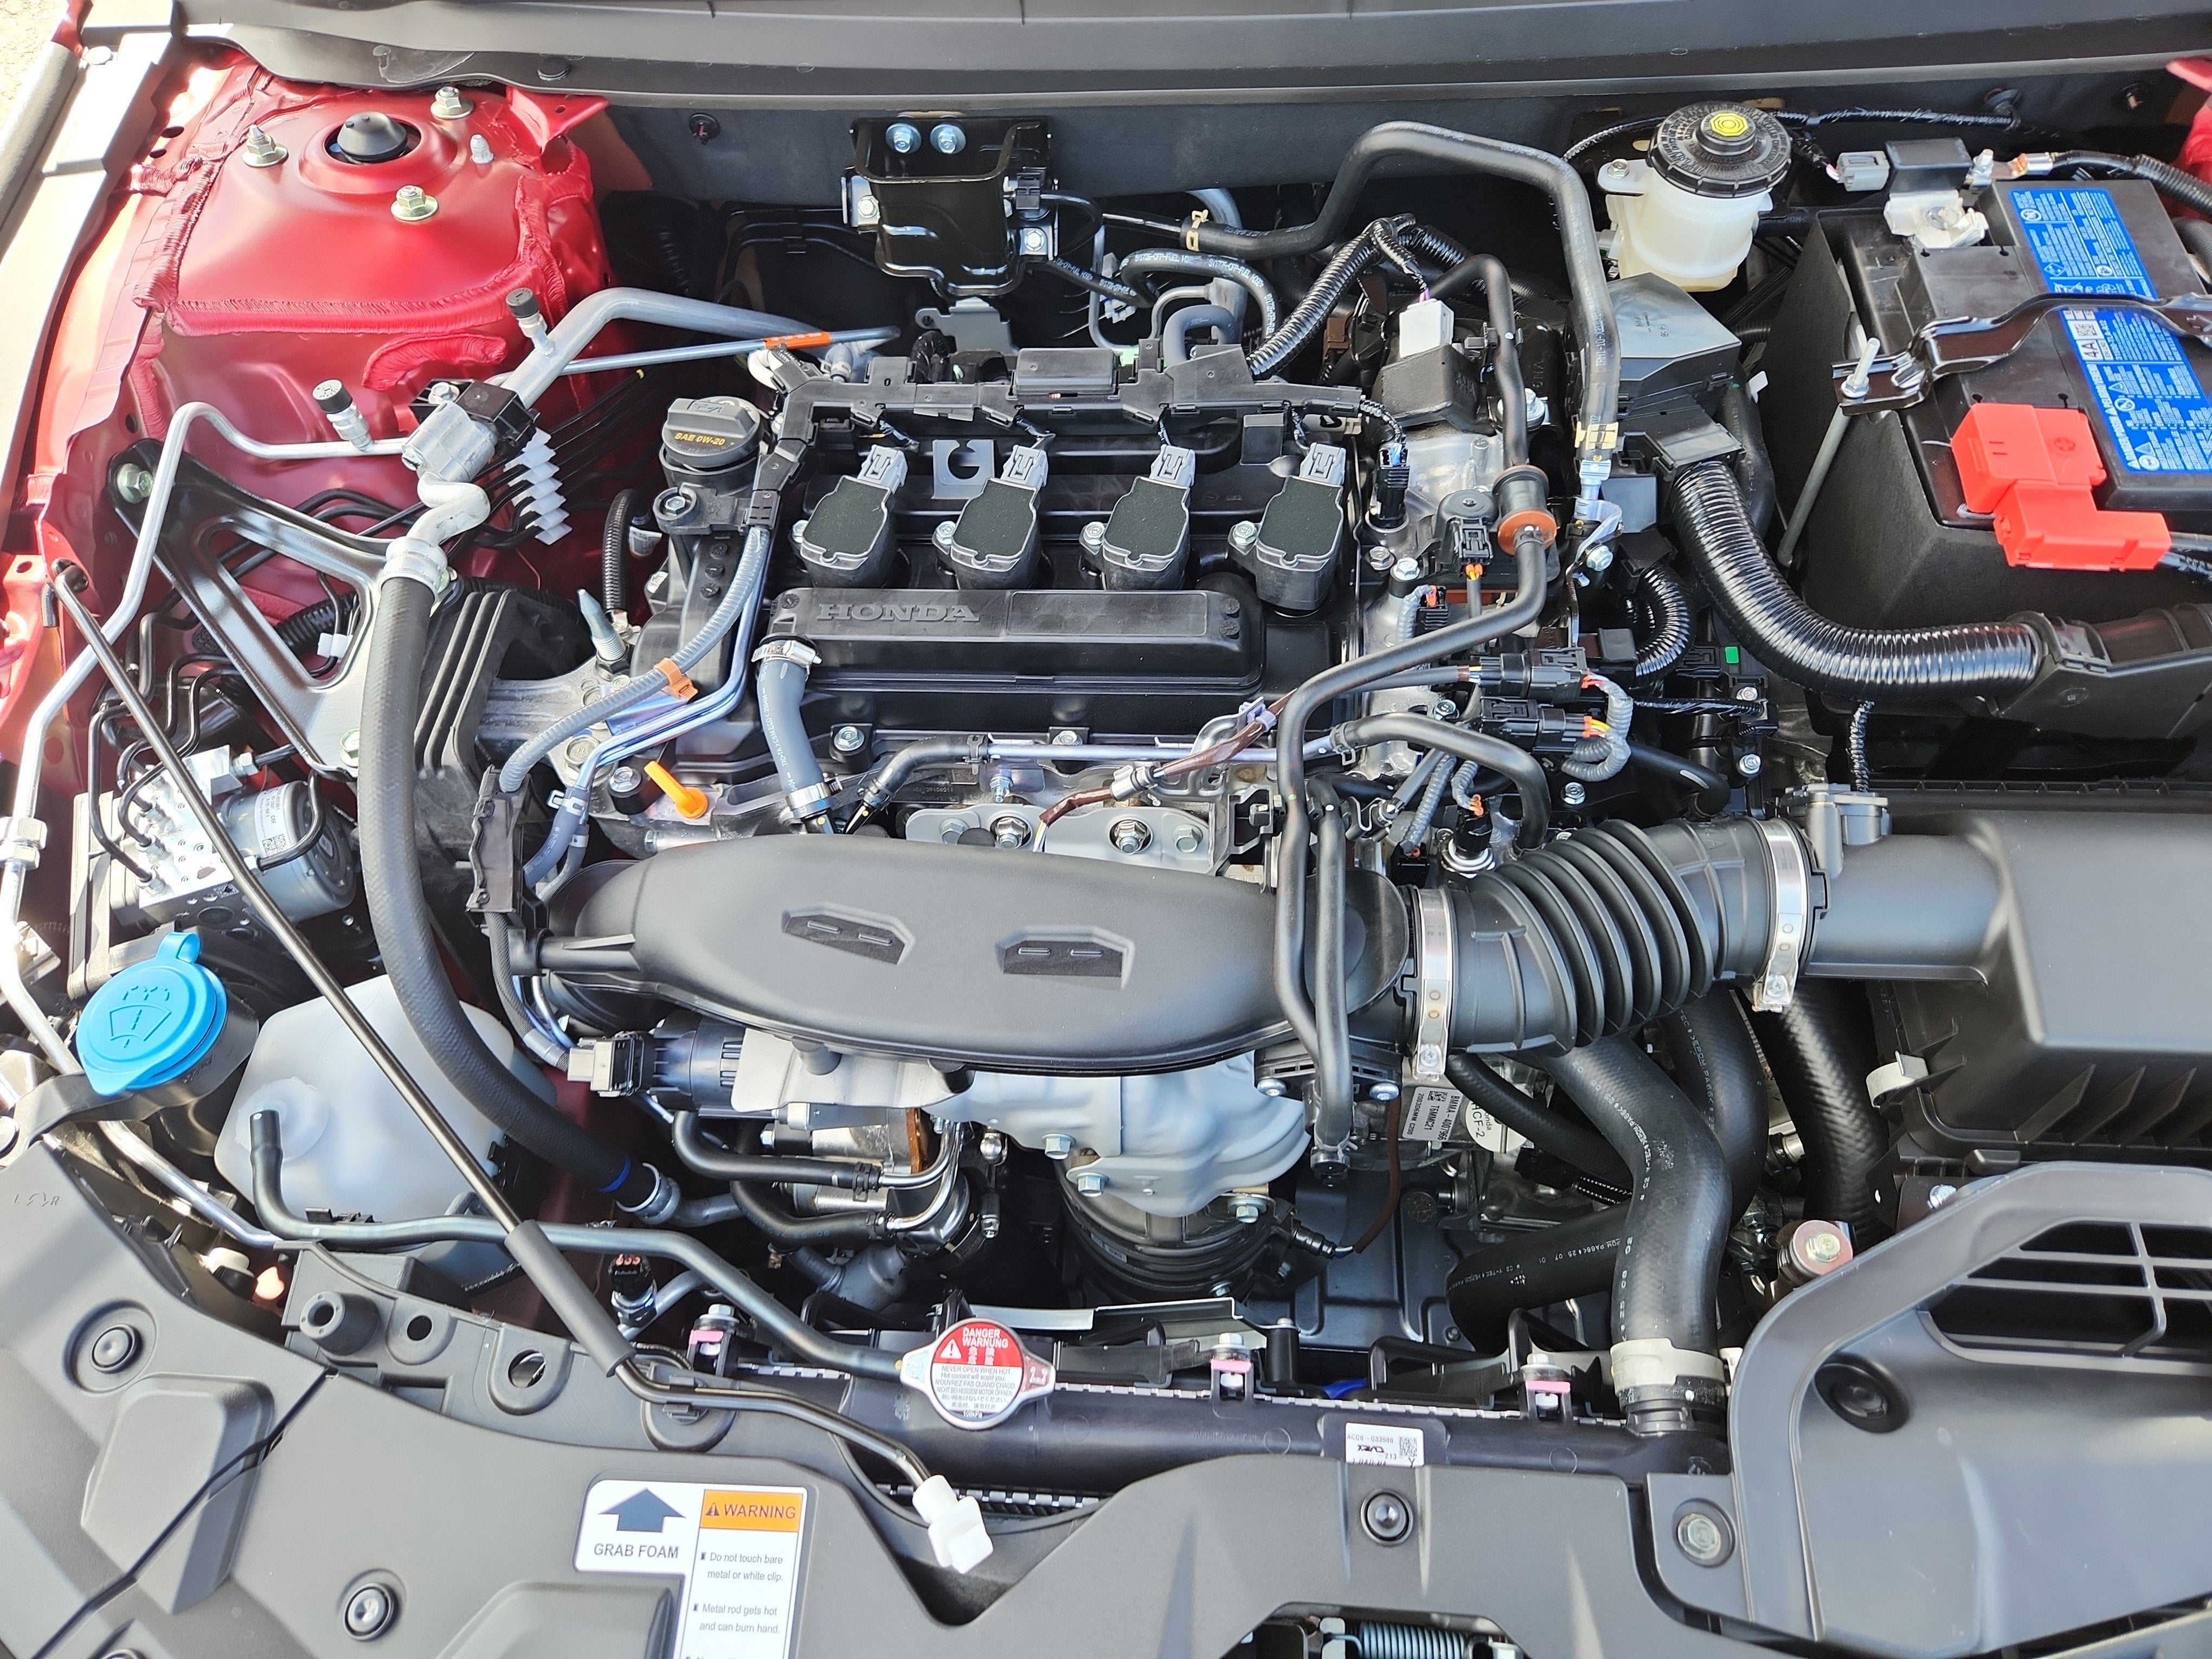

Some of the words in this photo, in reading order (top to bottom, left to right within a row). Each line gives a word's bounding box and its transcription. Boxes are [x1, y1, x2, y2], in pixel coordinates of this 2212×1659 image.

[2081, 342, 2099, 357] 4A
[674, 433, 696, 441] SAE
[696, 435, 726, 446] 0W-20
[816, 603, 980, 622] HONDA
[1624, 1236, 1633, 1255] 02
[962, 1327, 1000, 1338] DANGER
[962, 1336, 1008, 1348] WARNUNG
[724, 1503, 796, 1519] WARNING
[594, 1543, 634, 1557] GRAB
[638, 1545, 679, 1559] FOAM
[710, 1552, 722, 1561] Do
[724, 1553, 737, 1562] not
[740, 1554, 762, 1564] touch
[764, 1555, 783, 1565] bare
[707, 1570, 730, 1579] metal
[743, 1571, 765, 1581] white
[767, 1572, 783, 1583] clip.
[703, 1604, 725, 1614] Metal
[728, 1605, 741, 1615] rod
[743, 1606, 761, 1617] gets
[764, 1607, 777, 1616] hot
[699, 1622, 716, 1631] and
[736, 1623, 755, 1632] burn
[757, 1624, 780, 1634] hand.
